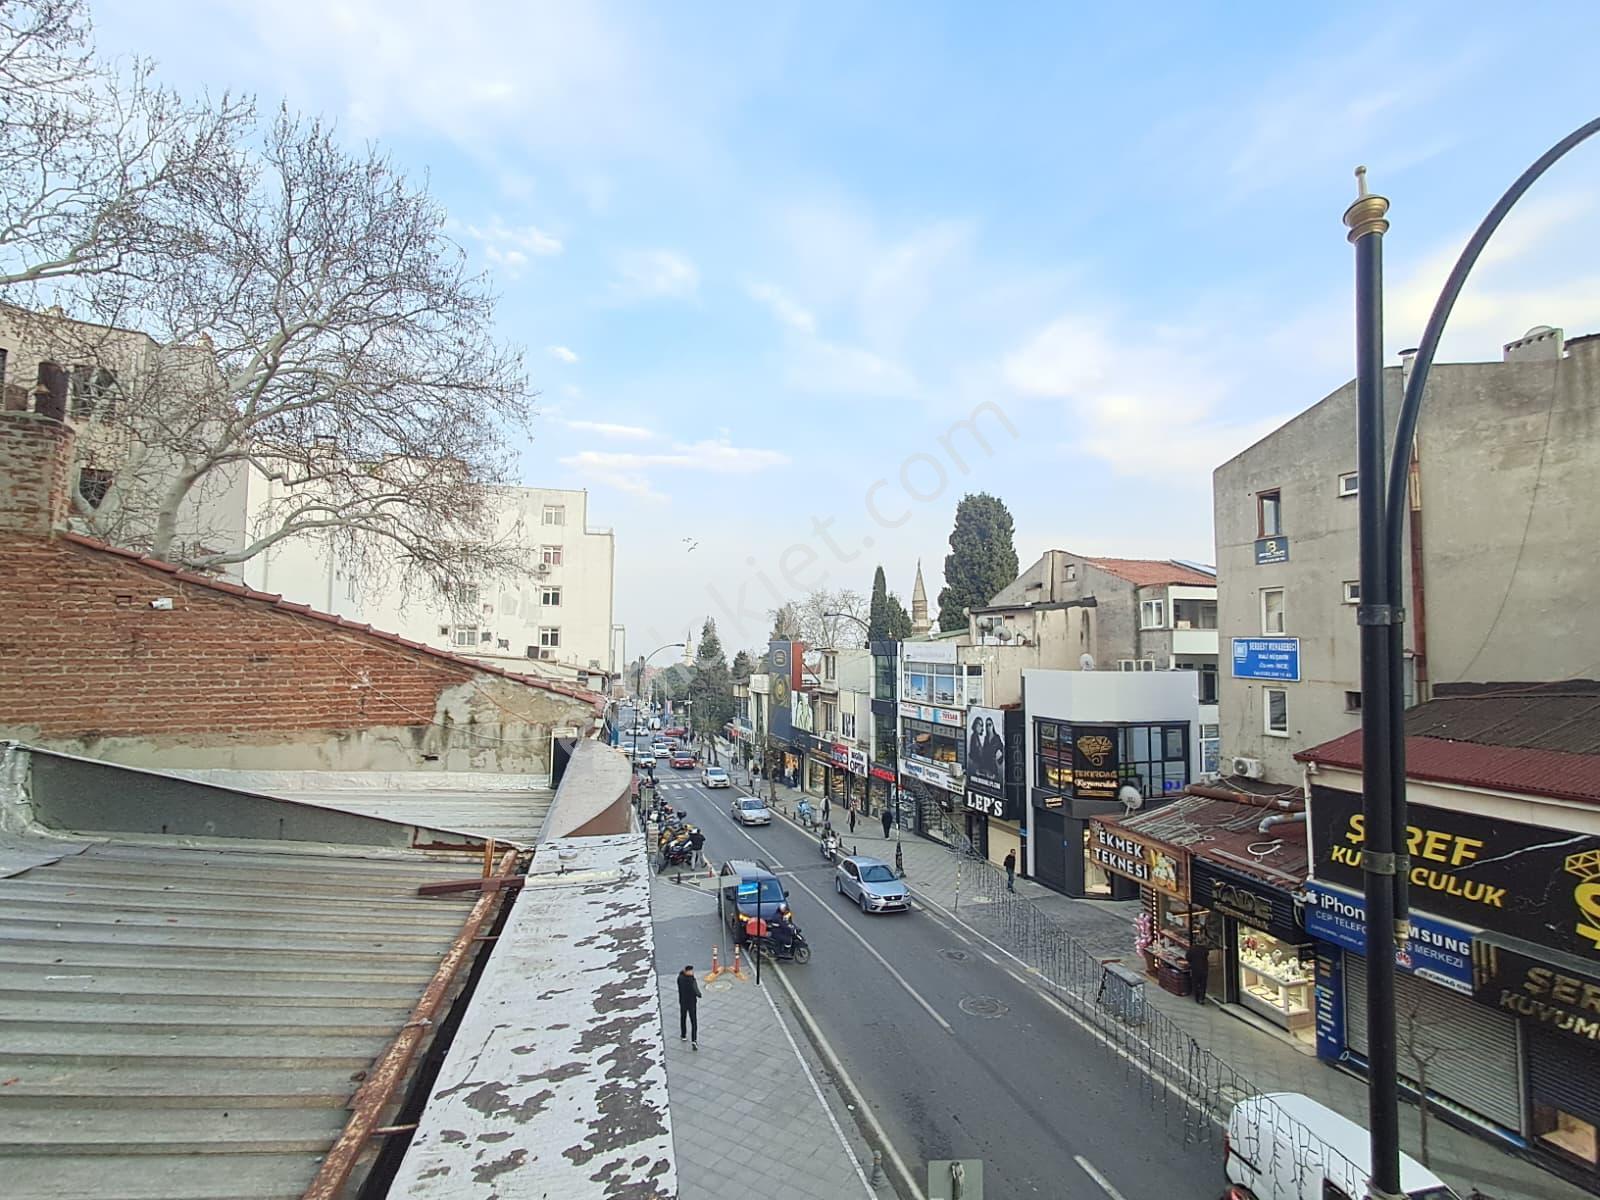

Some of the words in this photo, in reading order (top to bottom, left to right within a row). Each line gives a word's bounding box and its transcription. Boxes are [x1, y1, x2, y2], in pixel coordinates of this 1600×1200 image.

[967, 791, 1003, 817] LEP'S
[1099, 831, 1144, 858] EKMEK
[1345, 814, 1484, 866] ŞREF
[1094, 848, 1148, 880] TEKNESİ
[1331, 845, 1507, 907] KUCULUK
[1315, 910, 1333, 921] CEP
[1334, 916, 1367, 935] TELEFO
[1321, 893, 1366, 921] iPhon
[1408, 926, 1470, 956] MSUNG
